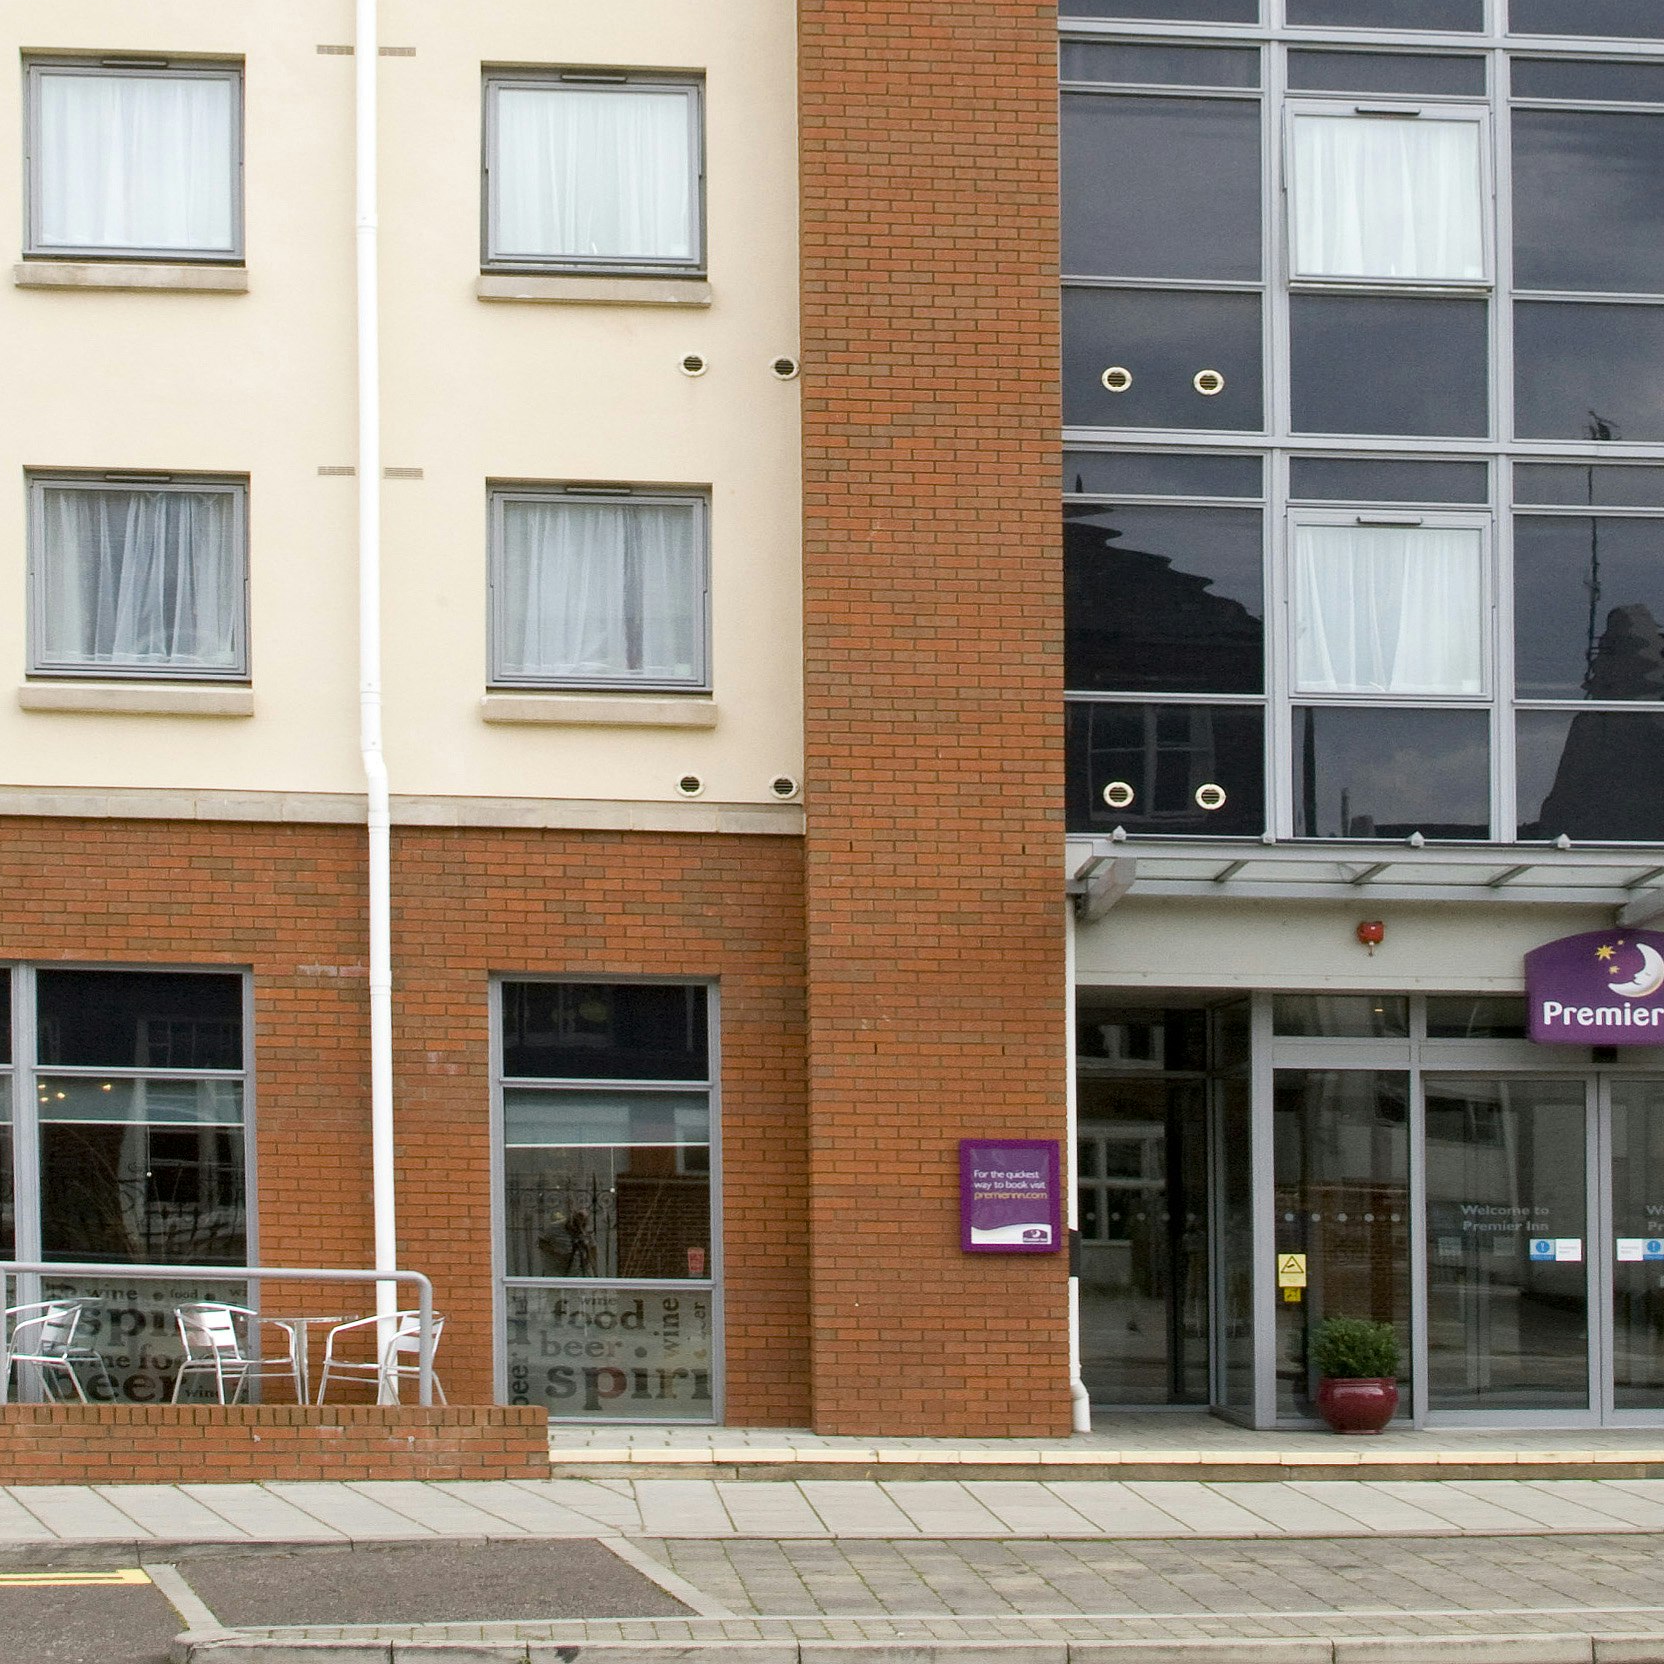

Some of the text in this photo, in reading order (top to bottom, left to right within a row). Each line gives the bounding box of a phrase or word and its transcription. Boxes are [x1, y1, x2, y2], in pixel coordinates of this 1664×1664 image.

[973, 1169, 1039, 1180] For the quickest
[974, 1181, 1046, 1190] way to book visit
[1460, 1204, 1550, 1215] Welcome to
[1462, 1220, 1550, 1231] Premier Inn
[170, 1288, 198, 1299] food
[551, 1298, 647, 1330] food
[539, 1329, 624, 1358] beer
